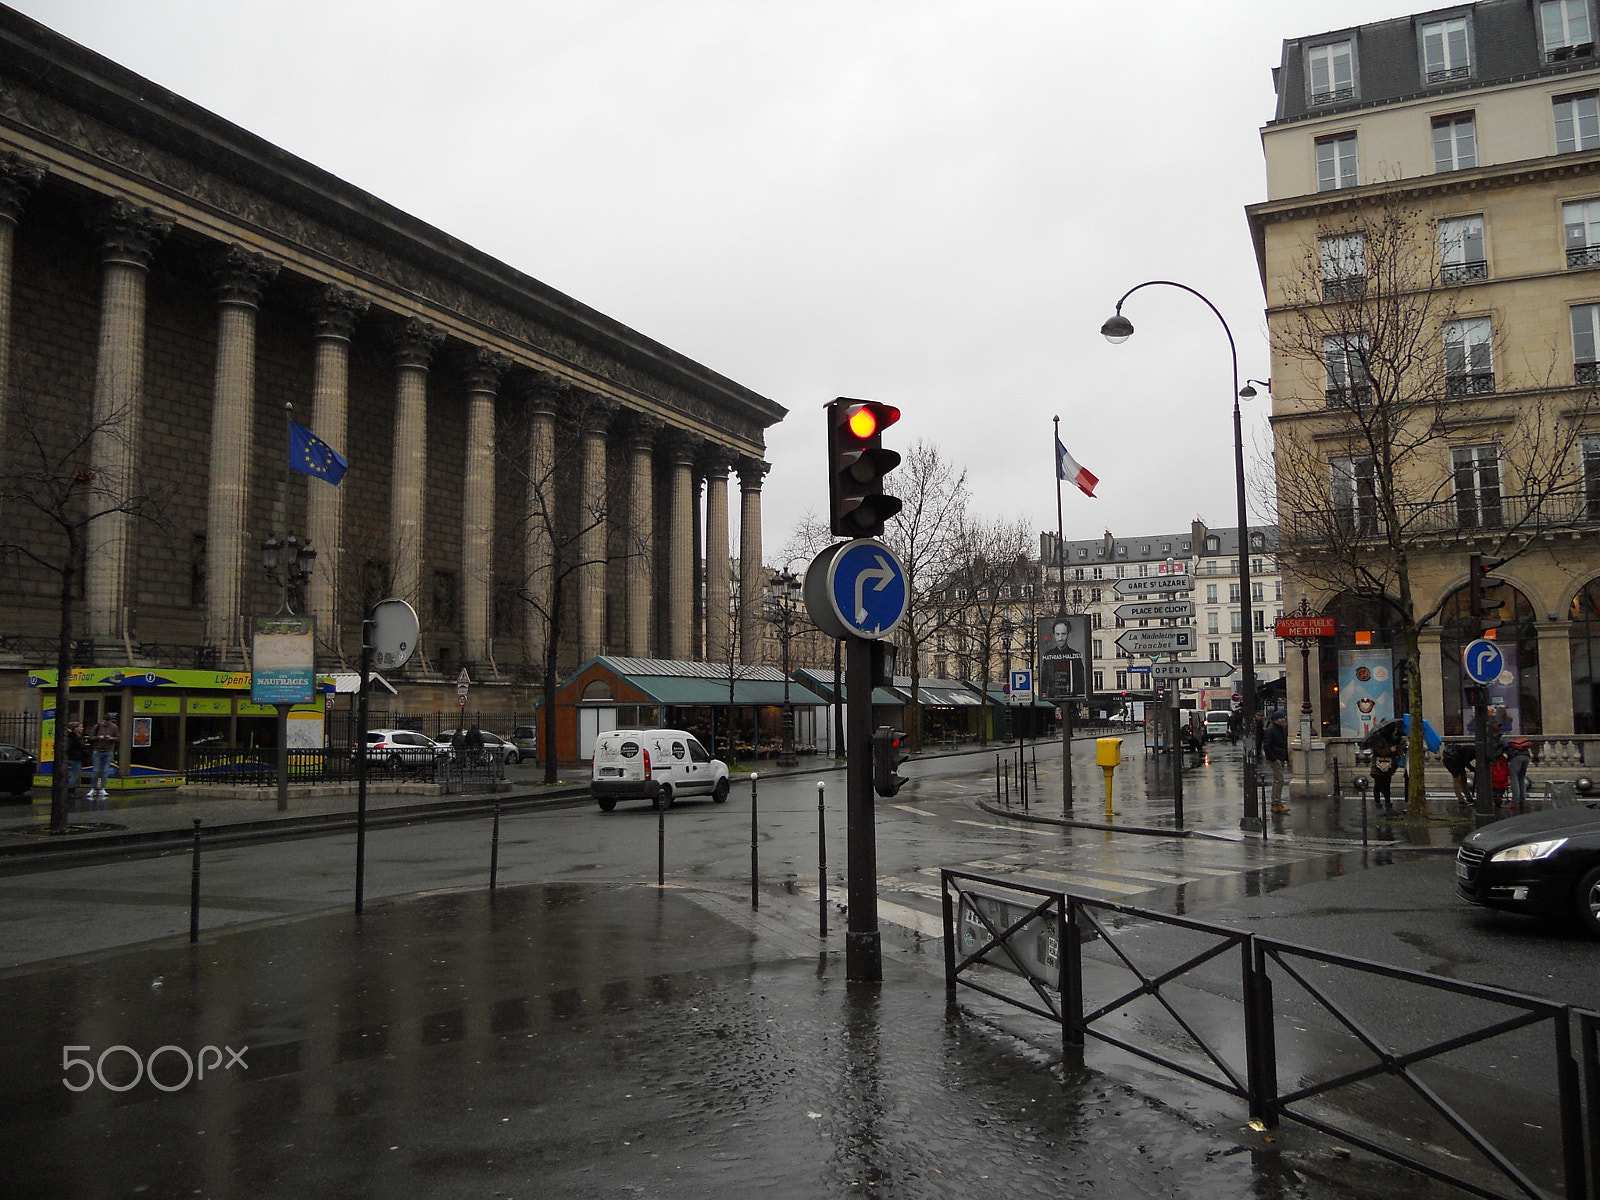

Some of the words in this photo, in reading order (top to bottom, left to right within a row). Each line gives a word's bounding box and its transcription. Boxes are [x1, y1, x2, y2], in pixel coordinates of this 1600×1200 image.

[1128, 582, 1148, 590] GARE
[1158, 579, 1187, 587] LAZARE
[1131, 607, 1152, 615] PLACE
[1165, 605, 1188, 613] CLICHY
[1310, 619, 1333, 627] PUBLIC
[1140, 631, 1176, 640] Madeleine
[1134, 641, 1171, 649] Tronchet
[1155, 665, 1188, 674] OPÉRA
[1015, 673, 1027, 689] P
